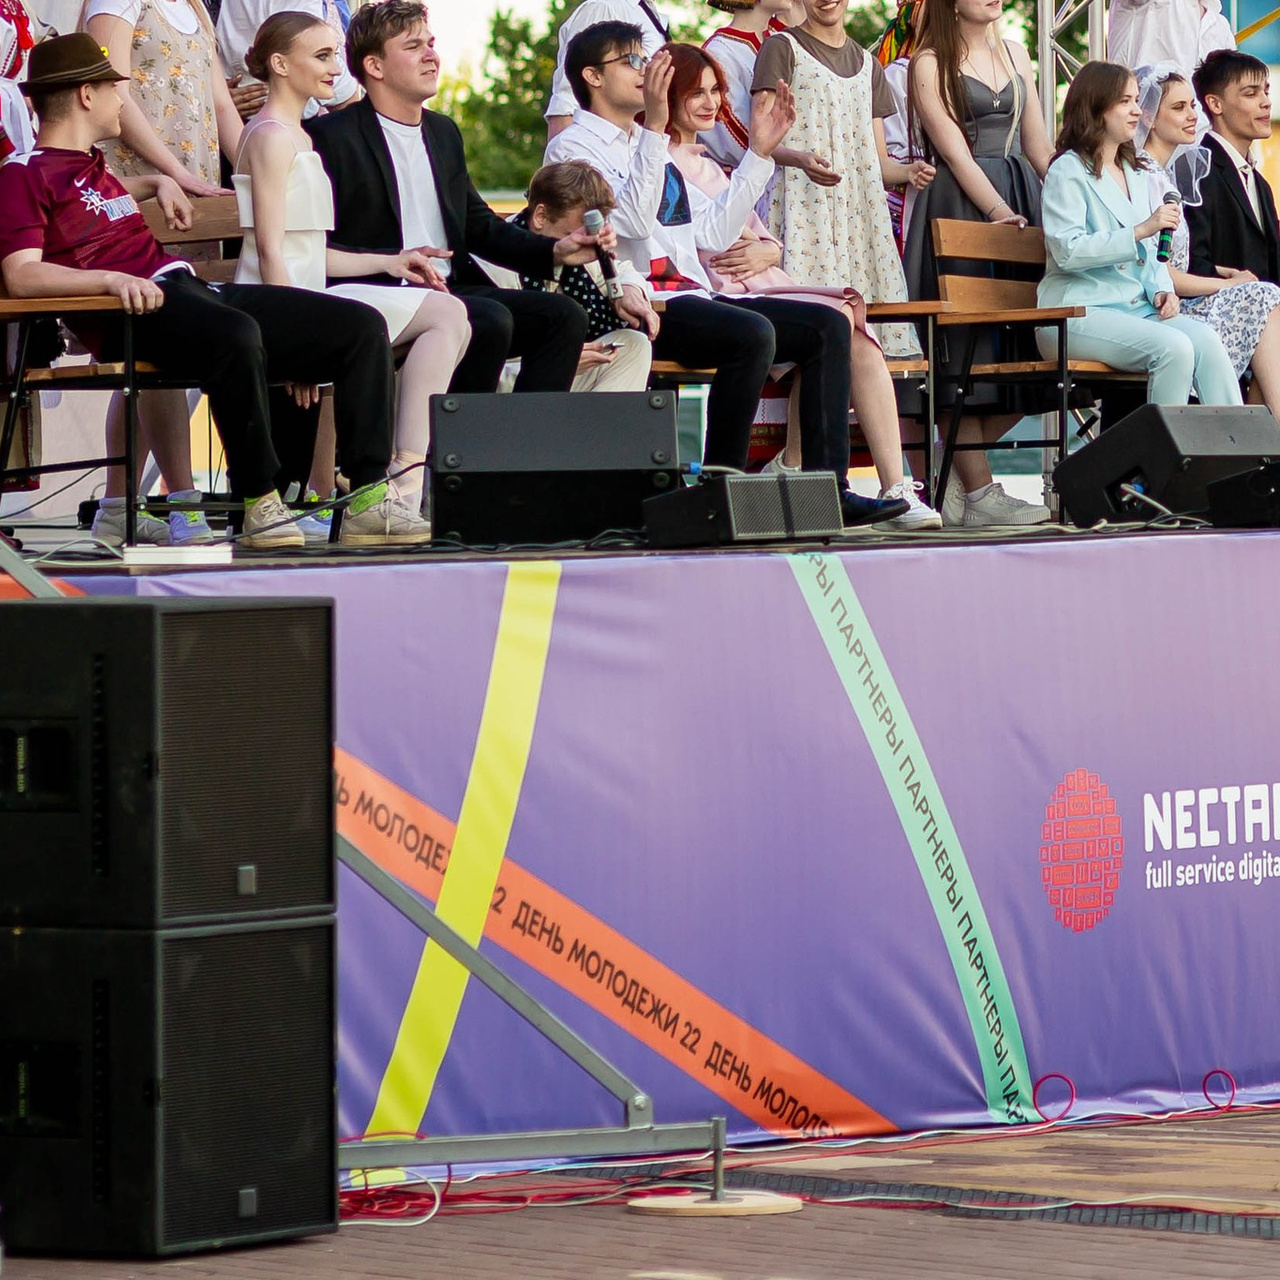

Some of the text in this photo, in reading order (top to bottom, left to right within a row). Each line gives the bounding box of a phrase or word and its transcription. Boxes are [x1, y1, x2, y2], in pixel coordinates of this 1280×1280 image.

[830, 596, 1009, 1067] ПАРТНЕРЫ ПАРТНЕРЫ ПАРТНЕРЫ
[1145, 858, 1172, 891] full
[1174, 853, 1235, 886] service
[490, 886, 507, 915] 2
[511, 900, 564, 955] ДЕНЬ
[566, 938, 680, 1039] МОЛОДЕЖИ
[679, 1021, 702, 1056] 22
[703, 1041, 752, 1093] ДЕНЬ
